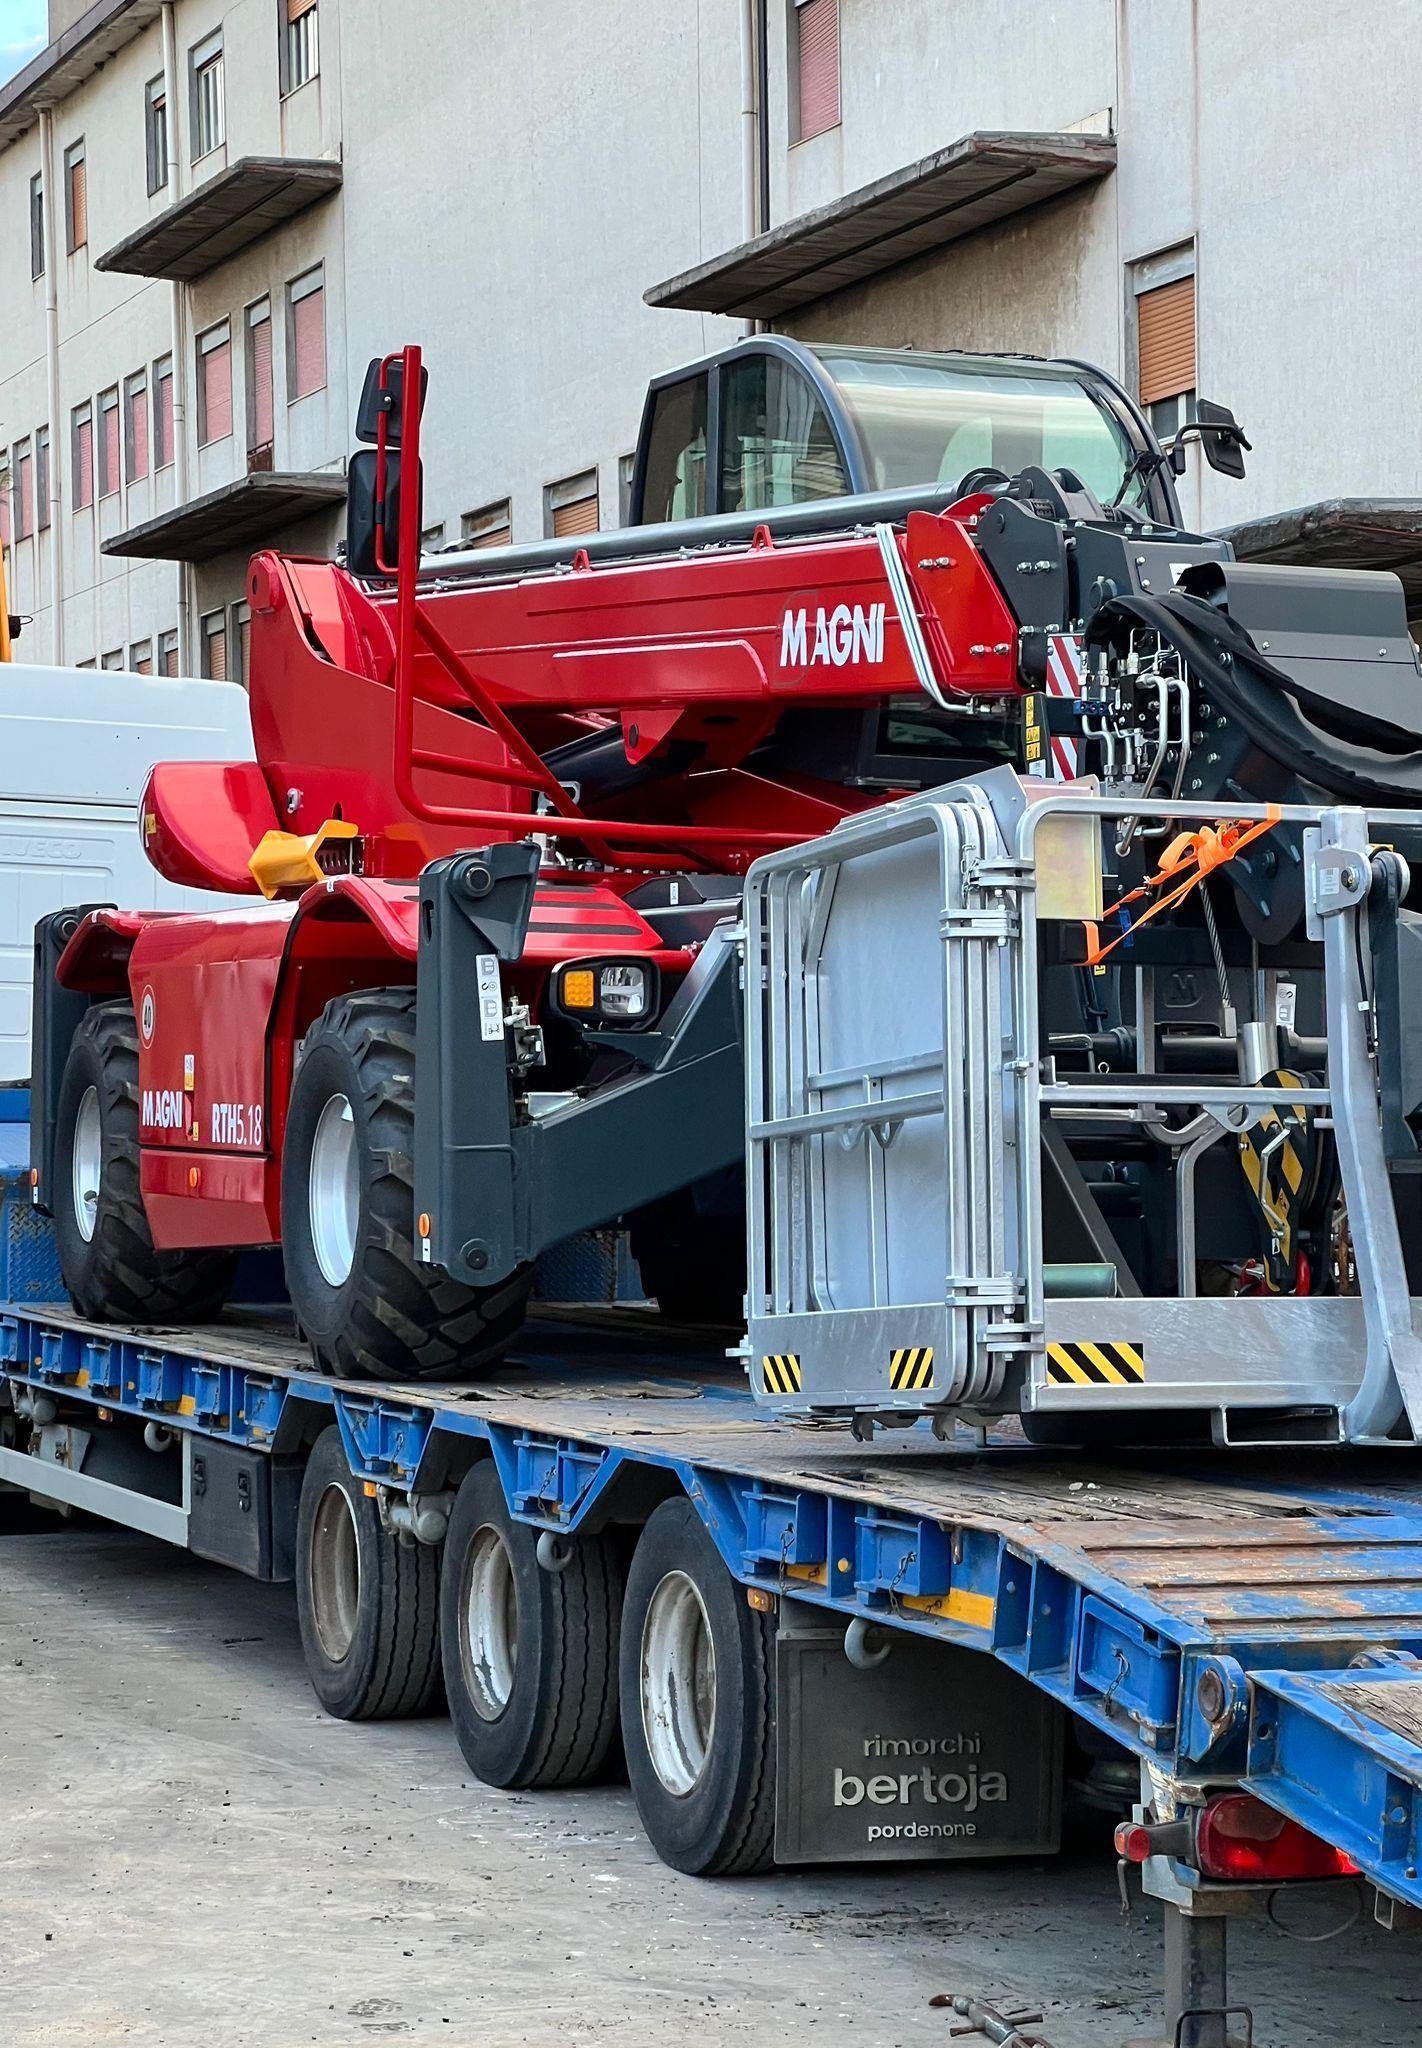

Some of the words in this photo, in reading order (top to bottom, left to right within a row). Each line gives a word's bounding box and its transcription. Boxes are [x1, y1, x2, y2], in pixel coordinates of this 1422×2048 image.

[780, 603, 885, 667] MAGNI
[144, 1005, 152, 1029] 40
[142, 1090, 183, 1128] MAGNI
[211, 1103, 262, 1146] RTH5.18
[864, 1732, 981, 1757] rimorchi
[834, 1764, 1008, 1812] bertoja
[867, 1822, 977, 1842] pordenone
